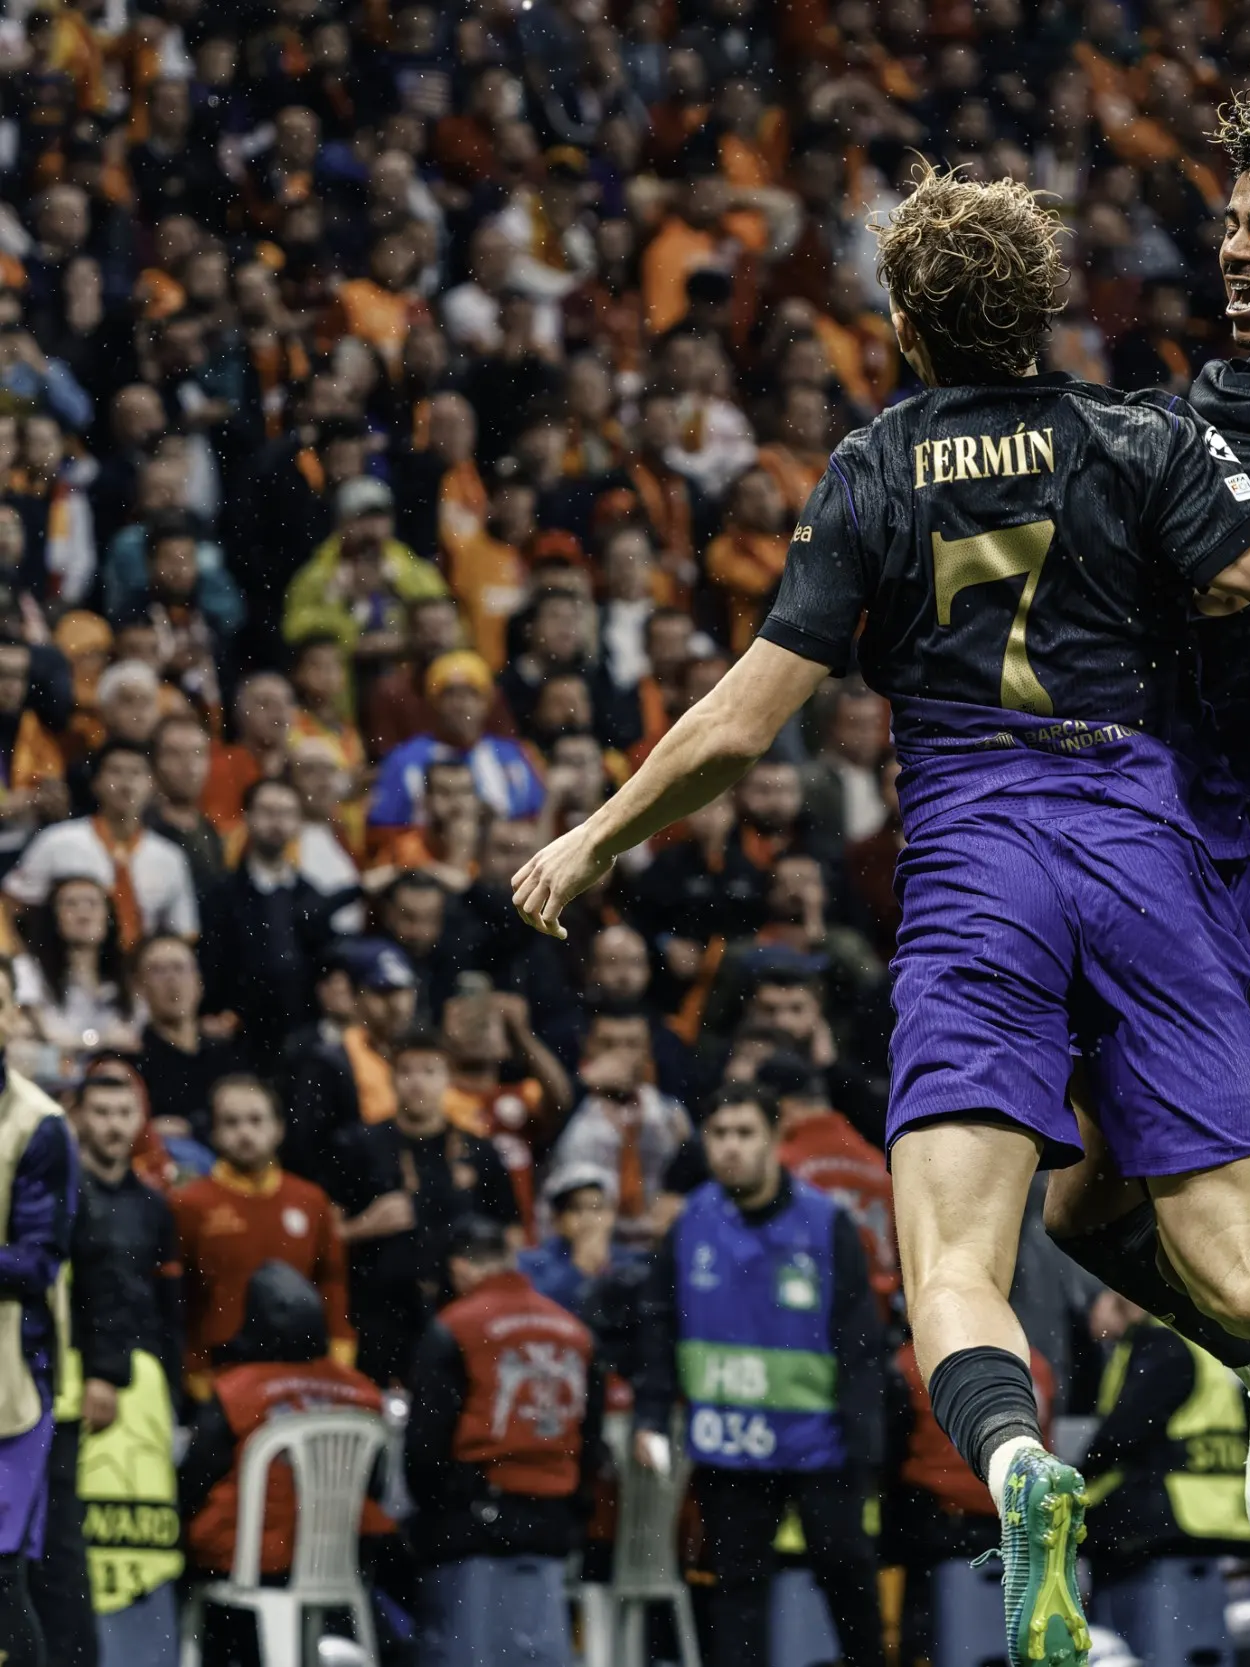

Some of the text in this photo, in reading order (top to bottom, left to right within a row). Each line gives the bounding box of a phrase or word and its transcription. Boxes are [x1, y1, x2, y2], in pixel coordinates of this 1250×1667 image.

[914, 423, 1055, 490] FERMÍN
[930, 518, 1056, 716] 7
[691, 1409, 777, 1459] 036
